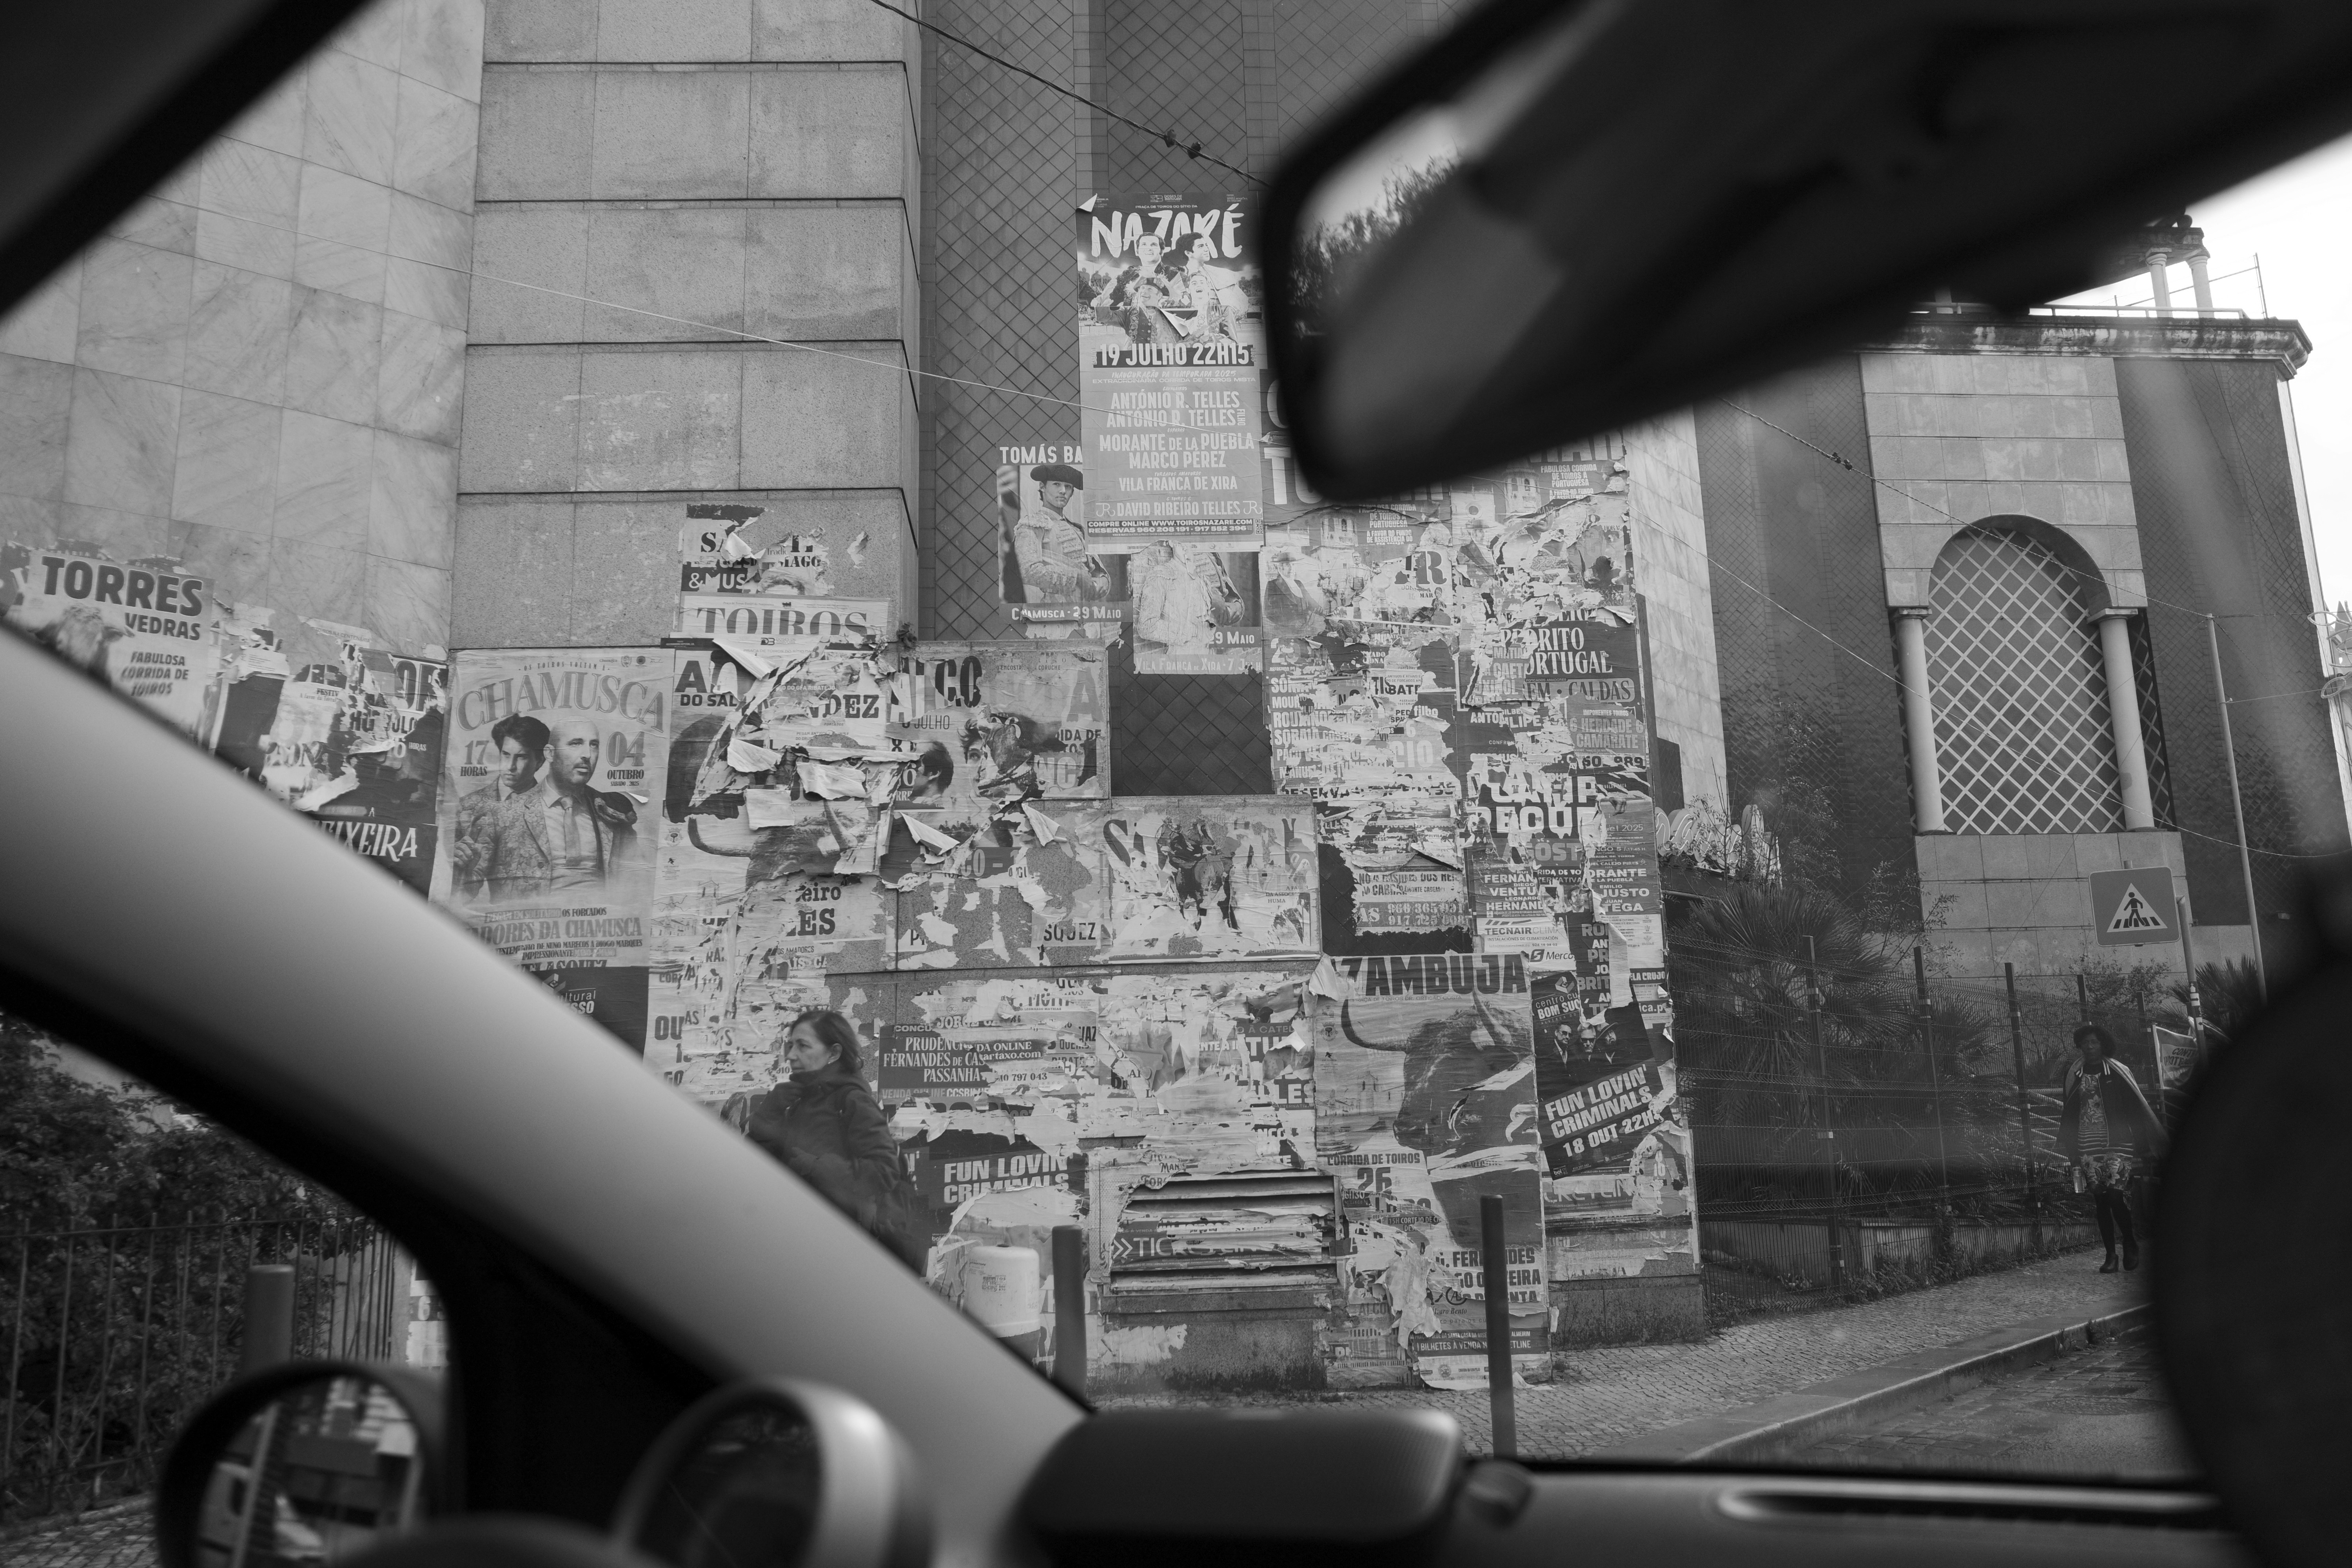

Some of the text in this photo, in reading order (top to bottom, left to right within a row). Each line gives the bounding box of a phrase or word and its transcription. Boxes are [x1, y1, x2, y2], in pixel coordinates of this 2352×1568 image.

[1091, 203, 1245, 258] NAZARÉ
[1100, 342, 1248, 366] 19 JULHO 22H15
[1112, 370, 1159, 379] INAUGURAÇÃO
[1111, 388, 1240, 409] ANTÓNIO R. TELLES
[1106, 407, 1236, 428] ANTÓNIO R. TELLES
[1237, 408, 1246, 426] FILHO
[1099, 432, 1254, 452] MORANTE DE LA PUEBLA
[999, 443, 1057, 464] TOMÁS
[1129, 447, 1226, 469] MARCO PÉREZ
[1541, 465, 1571, 473] FABULOSA
[1119, 475, 1238, 491] VILA FRANCA DE XIRA
[1552, 478, 1589, 488] PORTUGUESA
[1117, 501, 1240, 517] DAVID RIBEIRO TELLES
[1370, 520, 1408, 528] PORTUGUESA
[42, 555, 203, 617] TORRES
[1073, 606, 1090, 619] 29
[125, 612, 201, 641] VEDRAS
[696, 607, 867, 636] TOIROS
[340, 633, 370, 643] CENTENÁRIA
[130, 650, 186, 666] FABULOSA
[1227, 658, 1234, 670] 7
[120, 666, 189, 684] CORRIDA DE
[456, 671, 664, 733] CHAMUSCA
[680, 693, 738, 707] DO SAL
[1414, 705, 1439, 718] filho
[914, 715, 950, 730] JULHO
[1570, 718, 1644, 733] 6 HERDADE 6
[409, 743, 427, 752] HORAS
[1576, 733, 1639, 748] CAMARATE
[464, 740, 489, 765] 17
[606, 731, 646, 767] 04
[460, 766, 487, 777] HORAS
[607, 769, 644, 780] OUTUBRO
[1601, 888, 1650, 898] JUSTO
[572, 907, 607, 916] FORCADOS
[1388, 903, 1437, 913] 966 365
[1388, 915, 1437, 925] 917 725
[538, 917, 642, 940] DA CHAMUSCA
[615, 939, 643, 947] MARQUES
[522, 949, 574, 960] IMPRESSIONANTE
[1535, 995, 1565, 1009] centro
[1537, 1006, 1561, 1020] BOM
[993, 1041, 1032, 1053] ONLINE
[883, 1052, 963, 1067] FERNANDES DE
[923, 1067, 981, 1082] PASSANHA
[1011, 1072, 1048, 1082] 797 043
[881, 1089, 911, 1098] VENDA
[1544, 1064, 1647, 1122] FUN LOVIN'
[1550, 1085, 1653, 1138] CRIMINALS
[1563, 1123, 1619, 1157] 18 OUT
[1327, 1152, 1421, 1166] CORRIDA DE TOIROS
[944, 1159, 989, 1183] FUN
[1357, 1167, 1392, 1192] 26
[1421, 1341, 1480, 1351] BILHETES VENDA
